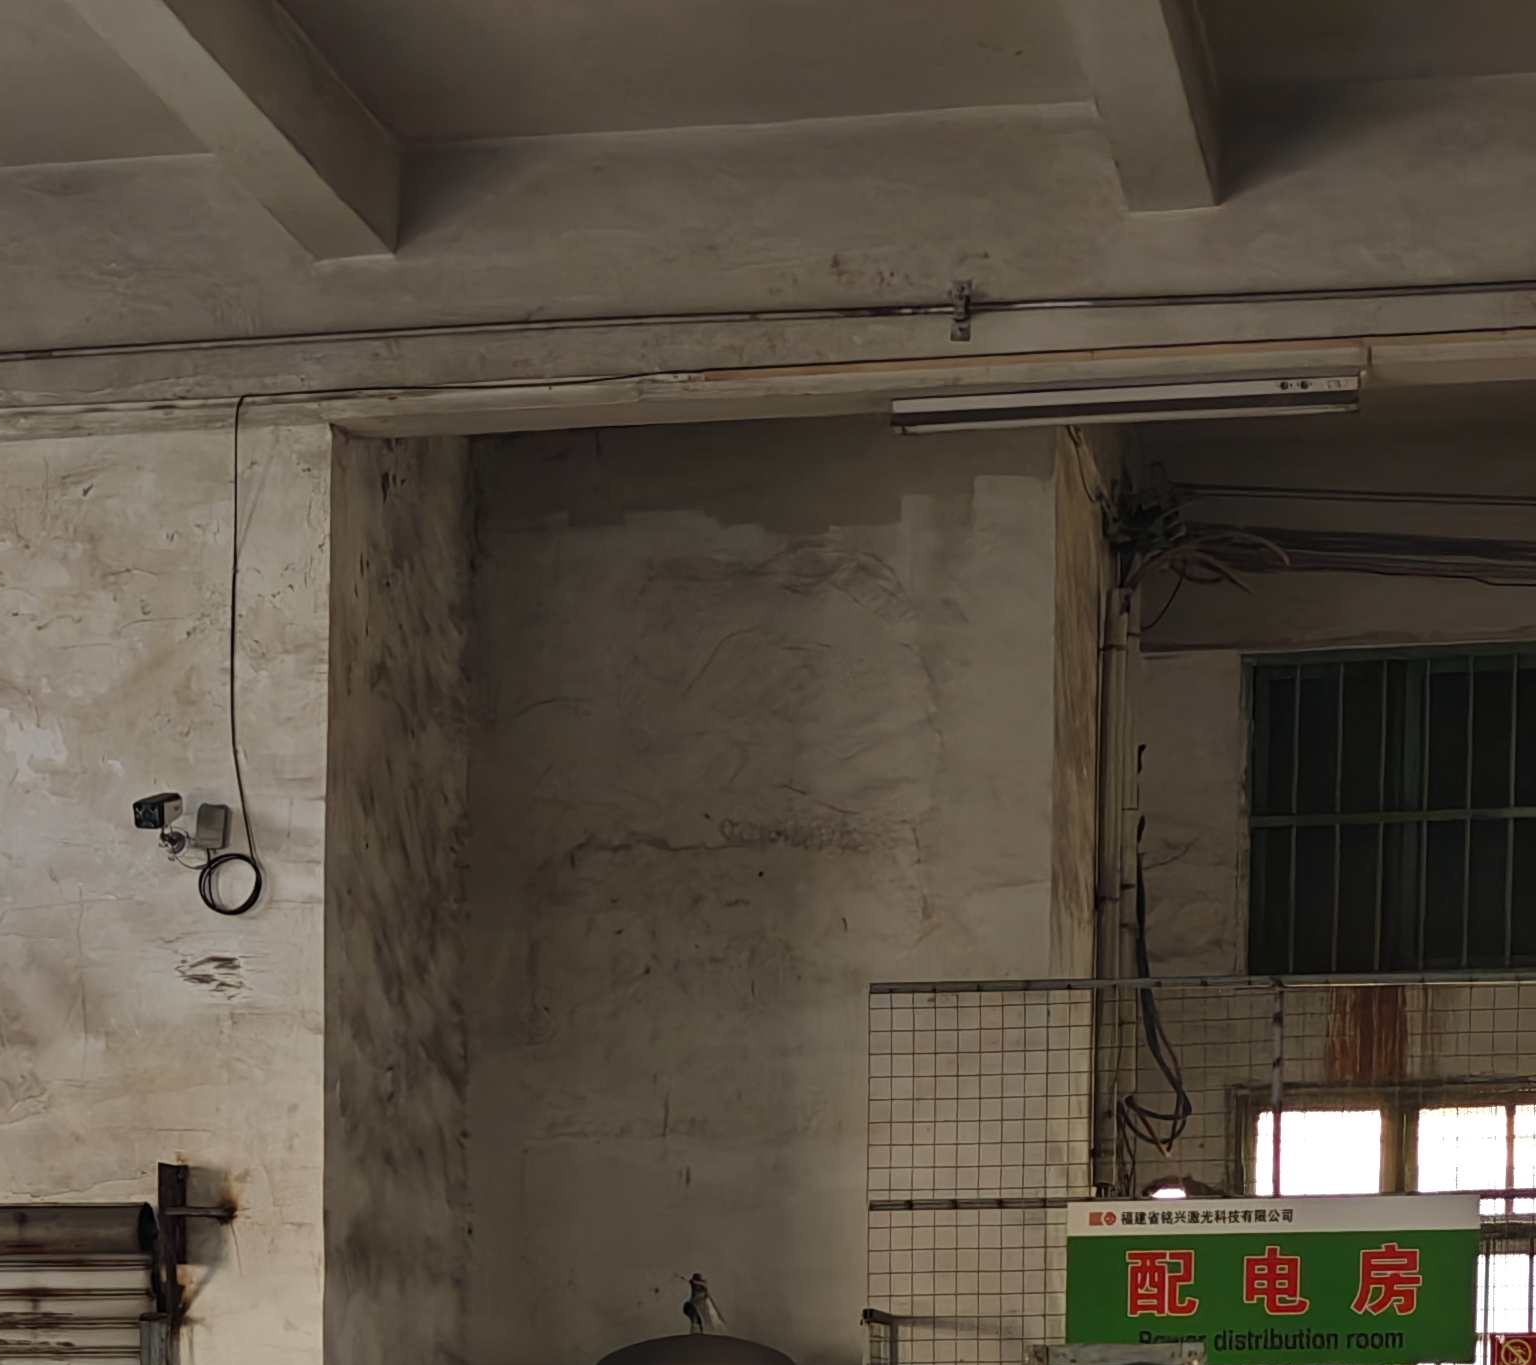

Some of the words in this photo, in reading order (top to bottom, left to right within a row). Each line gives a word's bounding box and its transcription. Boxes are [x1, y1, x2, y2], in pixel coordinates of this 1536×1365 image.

[1120, 1208, 1294, 1226] 福建省铭兴激光科技有限公司
[1125, 1242, 1423, 1318] 配电房
[1214, 1328, 1339, 1351] distribution
[1346, 1330, 1405, 1350] room
